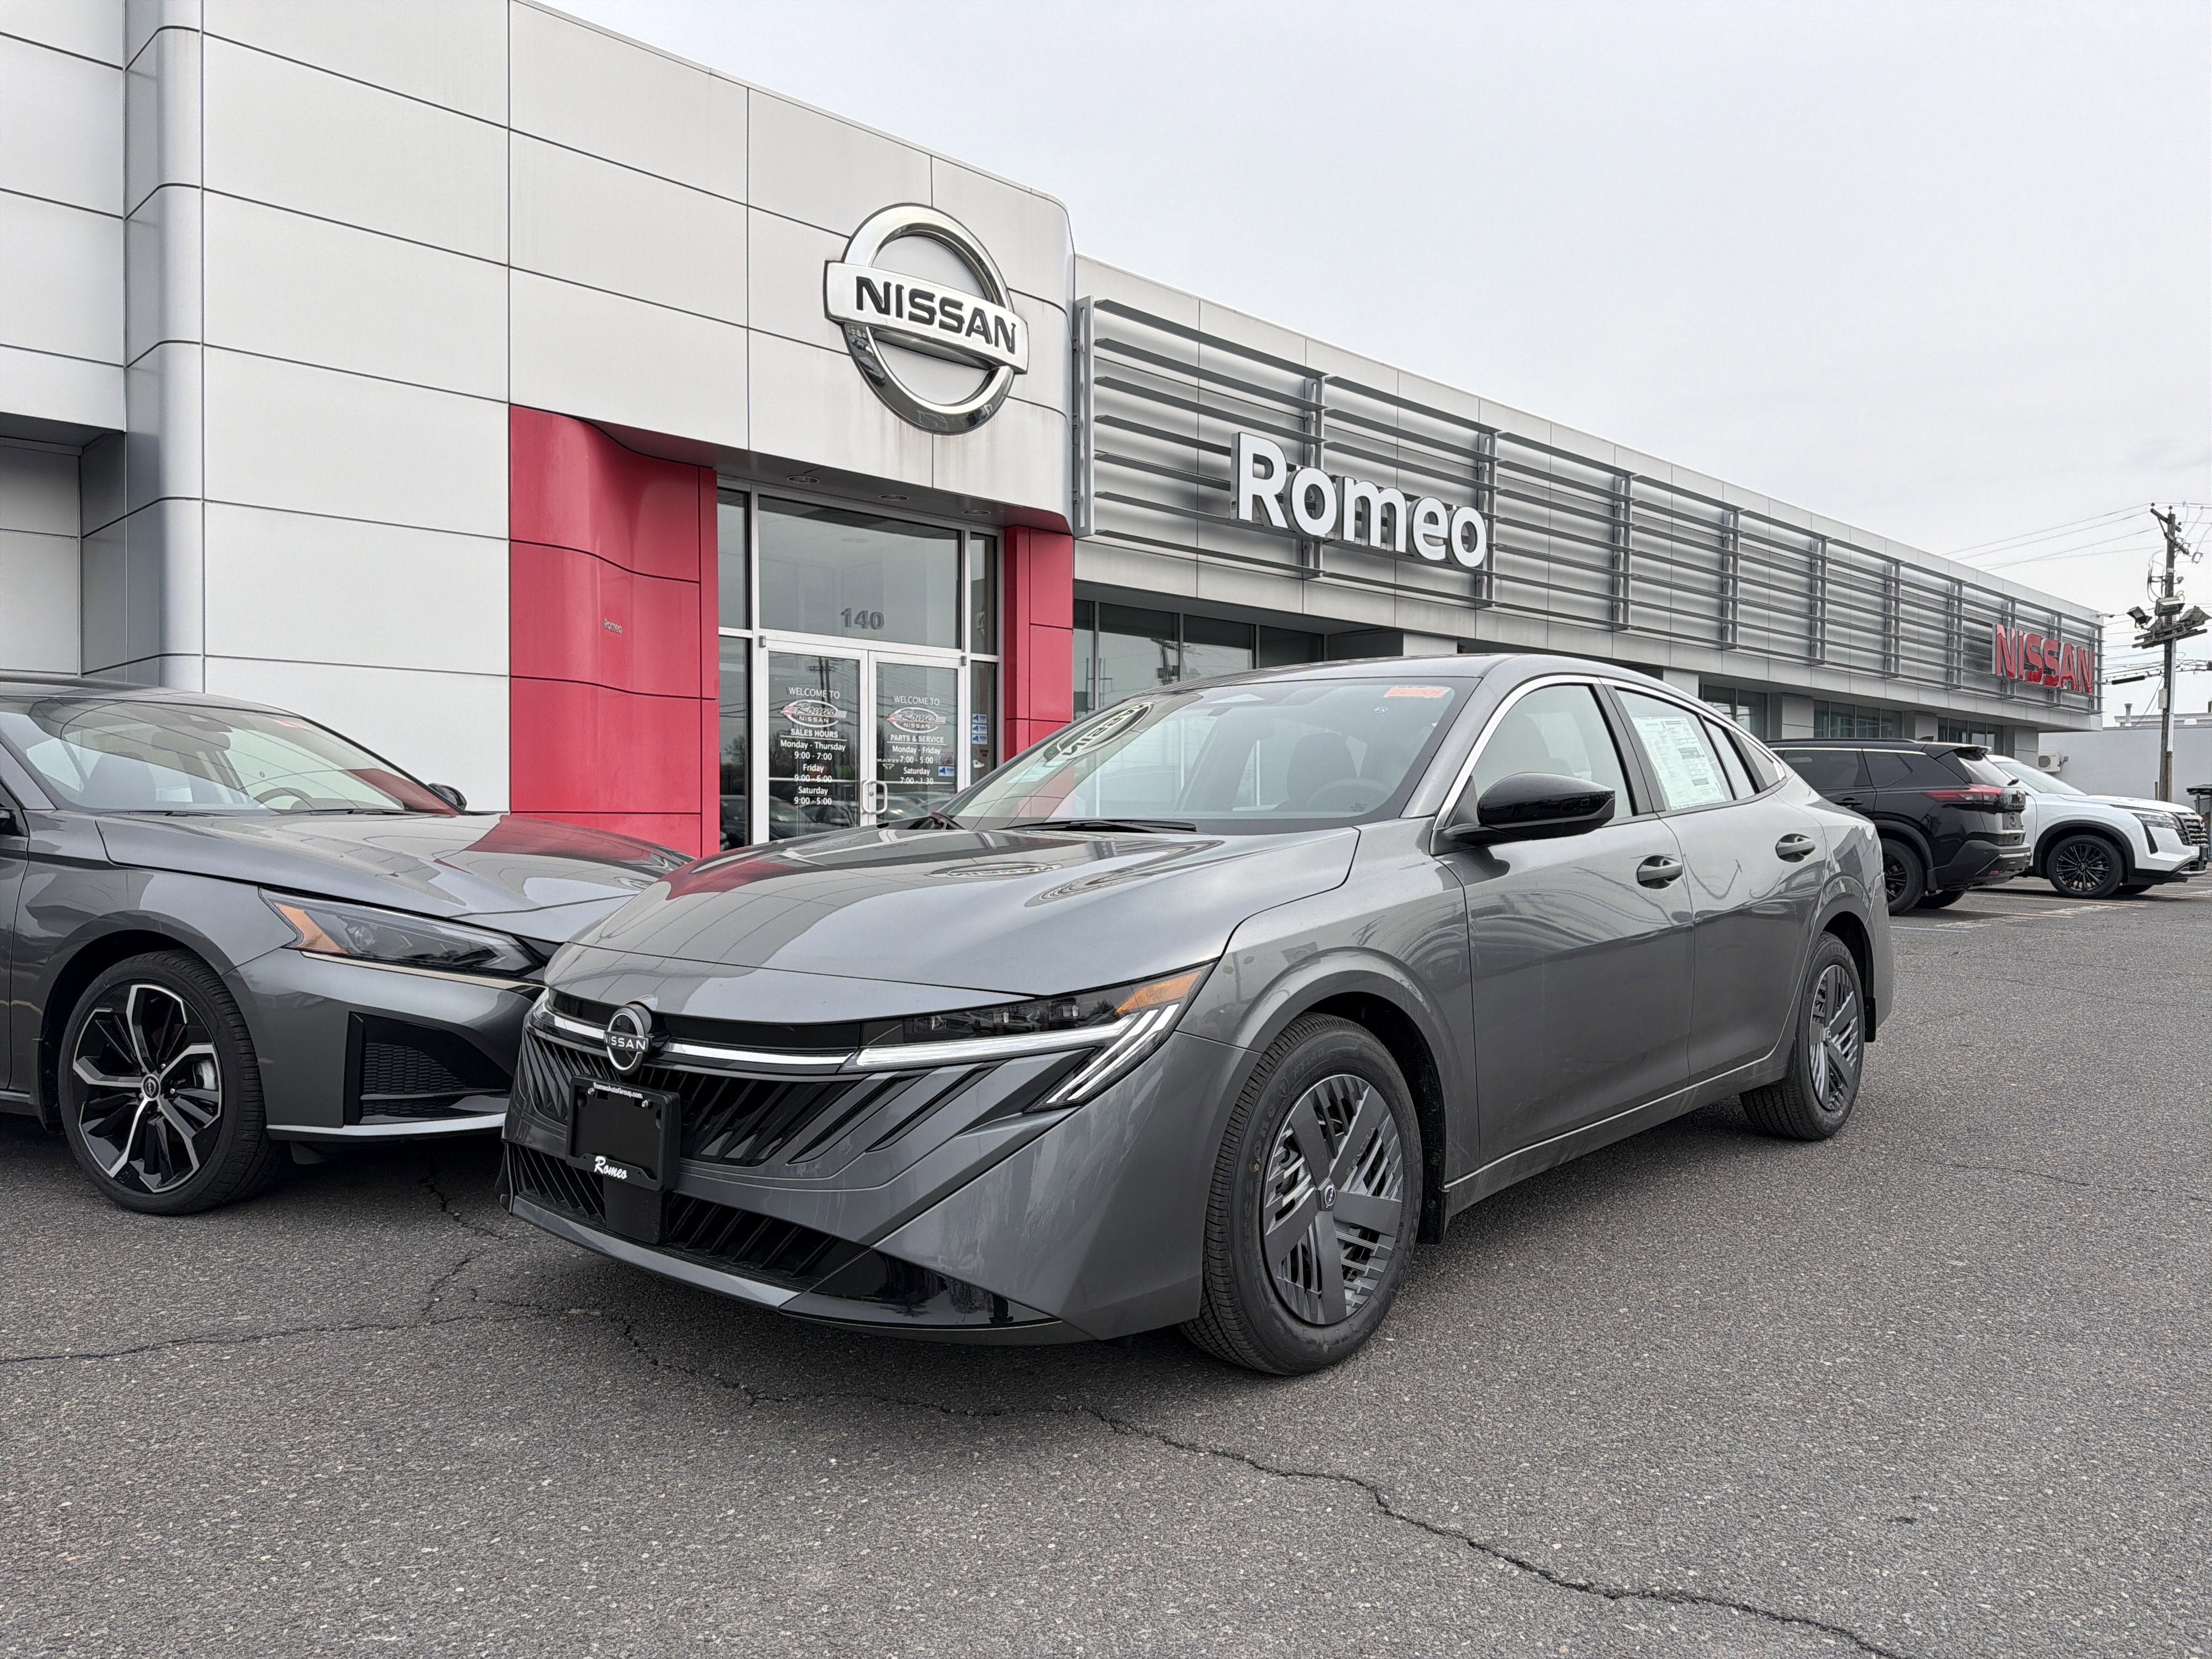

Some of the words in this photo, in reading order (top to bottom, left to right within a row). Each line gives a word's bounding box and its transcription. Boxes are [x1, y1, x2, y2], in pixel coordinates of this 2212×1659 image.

[856, 275, 1017, 355] NISSAN
[1232, 432, 1487, 567] Romeo
[840, 607, 885, 630] 140
[603, 618, 622, 635] Romeo
[1993, 623, 2094, 695] NISSAN
[788, 686, 827, 698] WELCOME
[829, 690, 840, 699] TO
[894, 695, 929, 705] WELCOME
[929, 698, 940, 706] TO
[793, 701, 836, 716] Romeo
[900, 708, 938, 723] Romeo
[791, 728, 812, 736] SALES
[815, 730, 838, 738] HOURS
[780, 739, 808, 750] Monday
[814, 741, 846, 752] Thursday
[892, 745, 917, 754] Monday
[922, 746, 941, 755] Friday
[794, 751, 810, 759] 9:00
[816, 752, 832, 760] 7:00
[919, 756, 934, 764] 5:00
[803, 763, 824, 774] Friday
[903, 766, 930, 776] Saturday
[794, 774, 810, 782] 9:00
[816, 775, 832, 783] 6:00
[900, 776, 915, 785] 7:00
[920, 777, 934, 785] 1:30
[798, 786, 828, 796] Saturday
[794, 797, 810, 805] 9:00
[816, 797, 832, 805] 5:00
[603, 1032, 646, 1051] NISSAN
[592, 1081, 644, 1099] RomeoAutoGroup.com
[594, 1155, 628, 1180] Romeo
